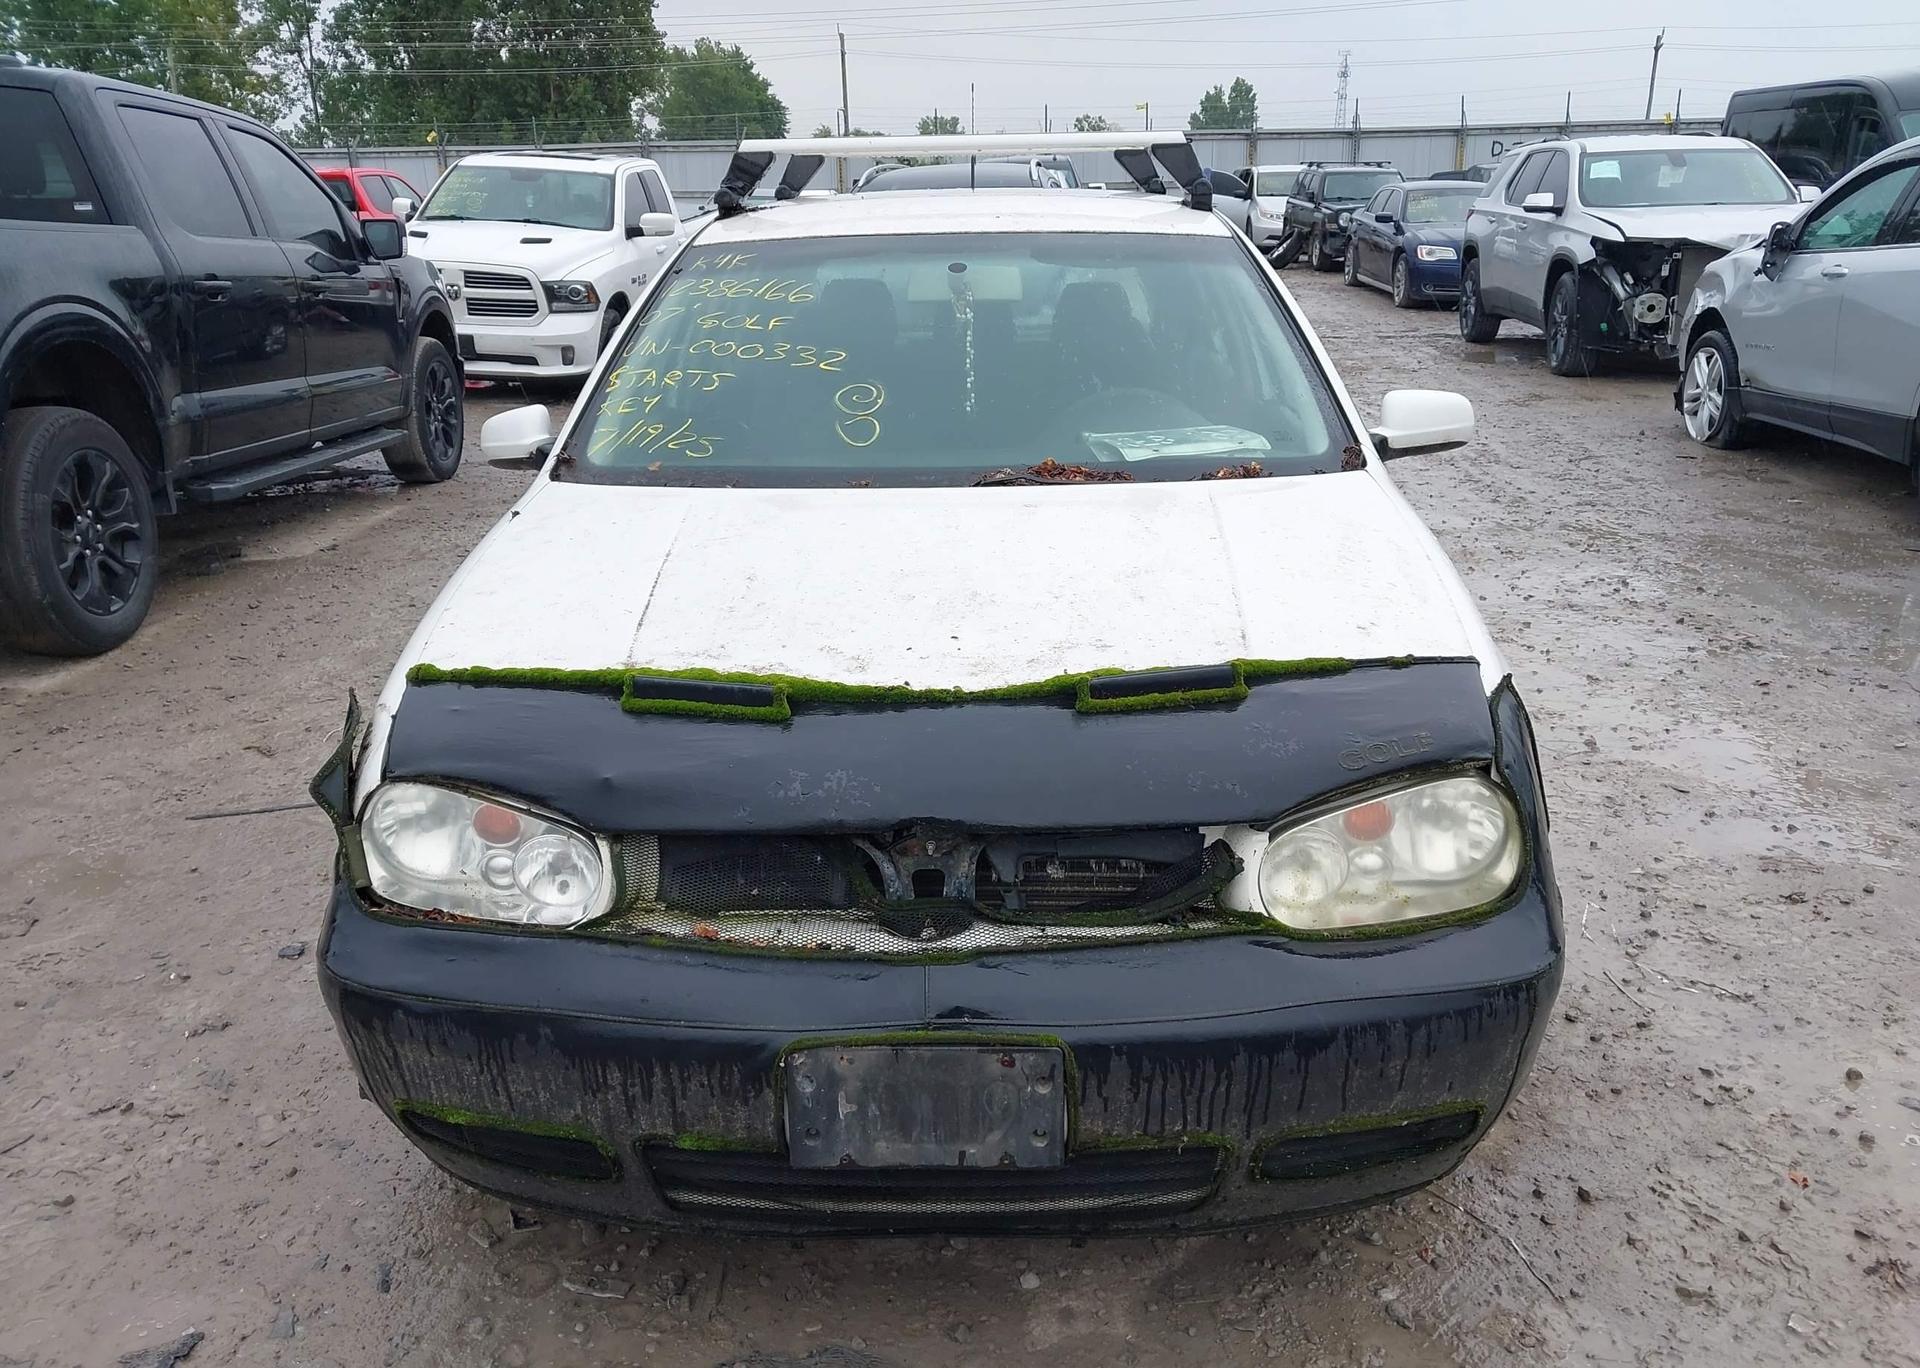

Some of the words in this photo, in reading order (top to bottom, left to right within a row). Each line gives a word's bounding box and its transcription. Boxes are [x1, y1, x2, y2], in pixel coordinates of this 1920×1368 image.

[696, 311, 795, 331] GOLF
[596, 394, 663, 416] KEY
[586, 417, 726, 458] 7/19/25
[1337, 731, 1435, 771] GOLF
